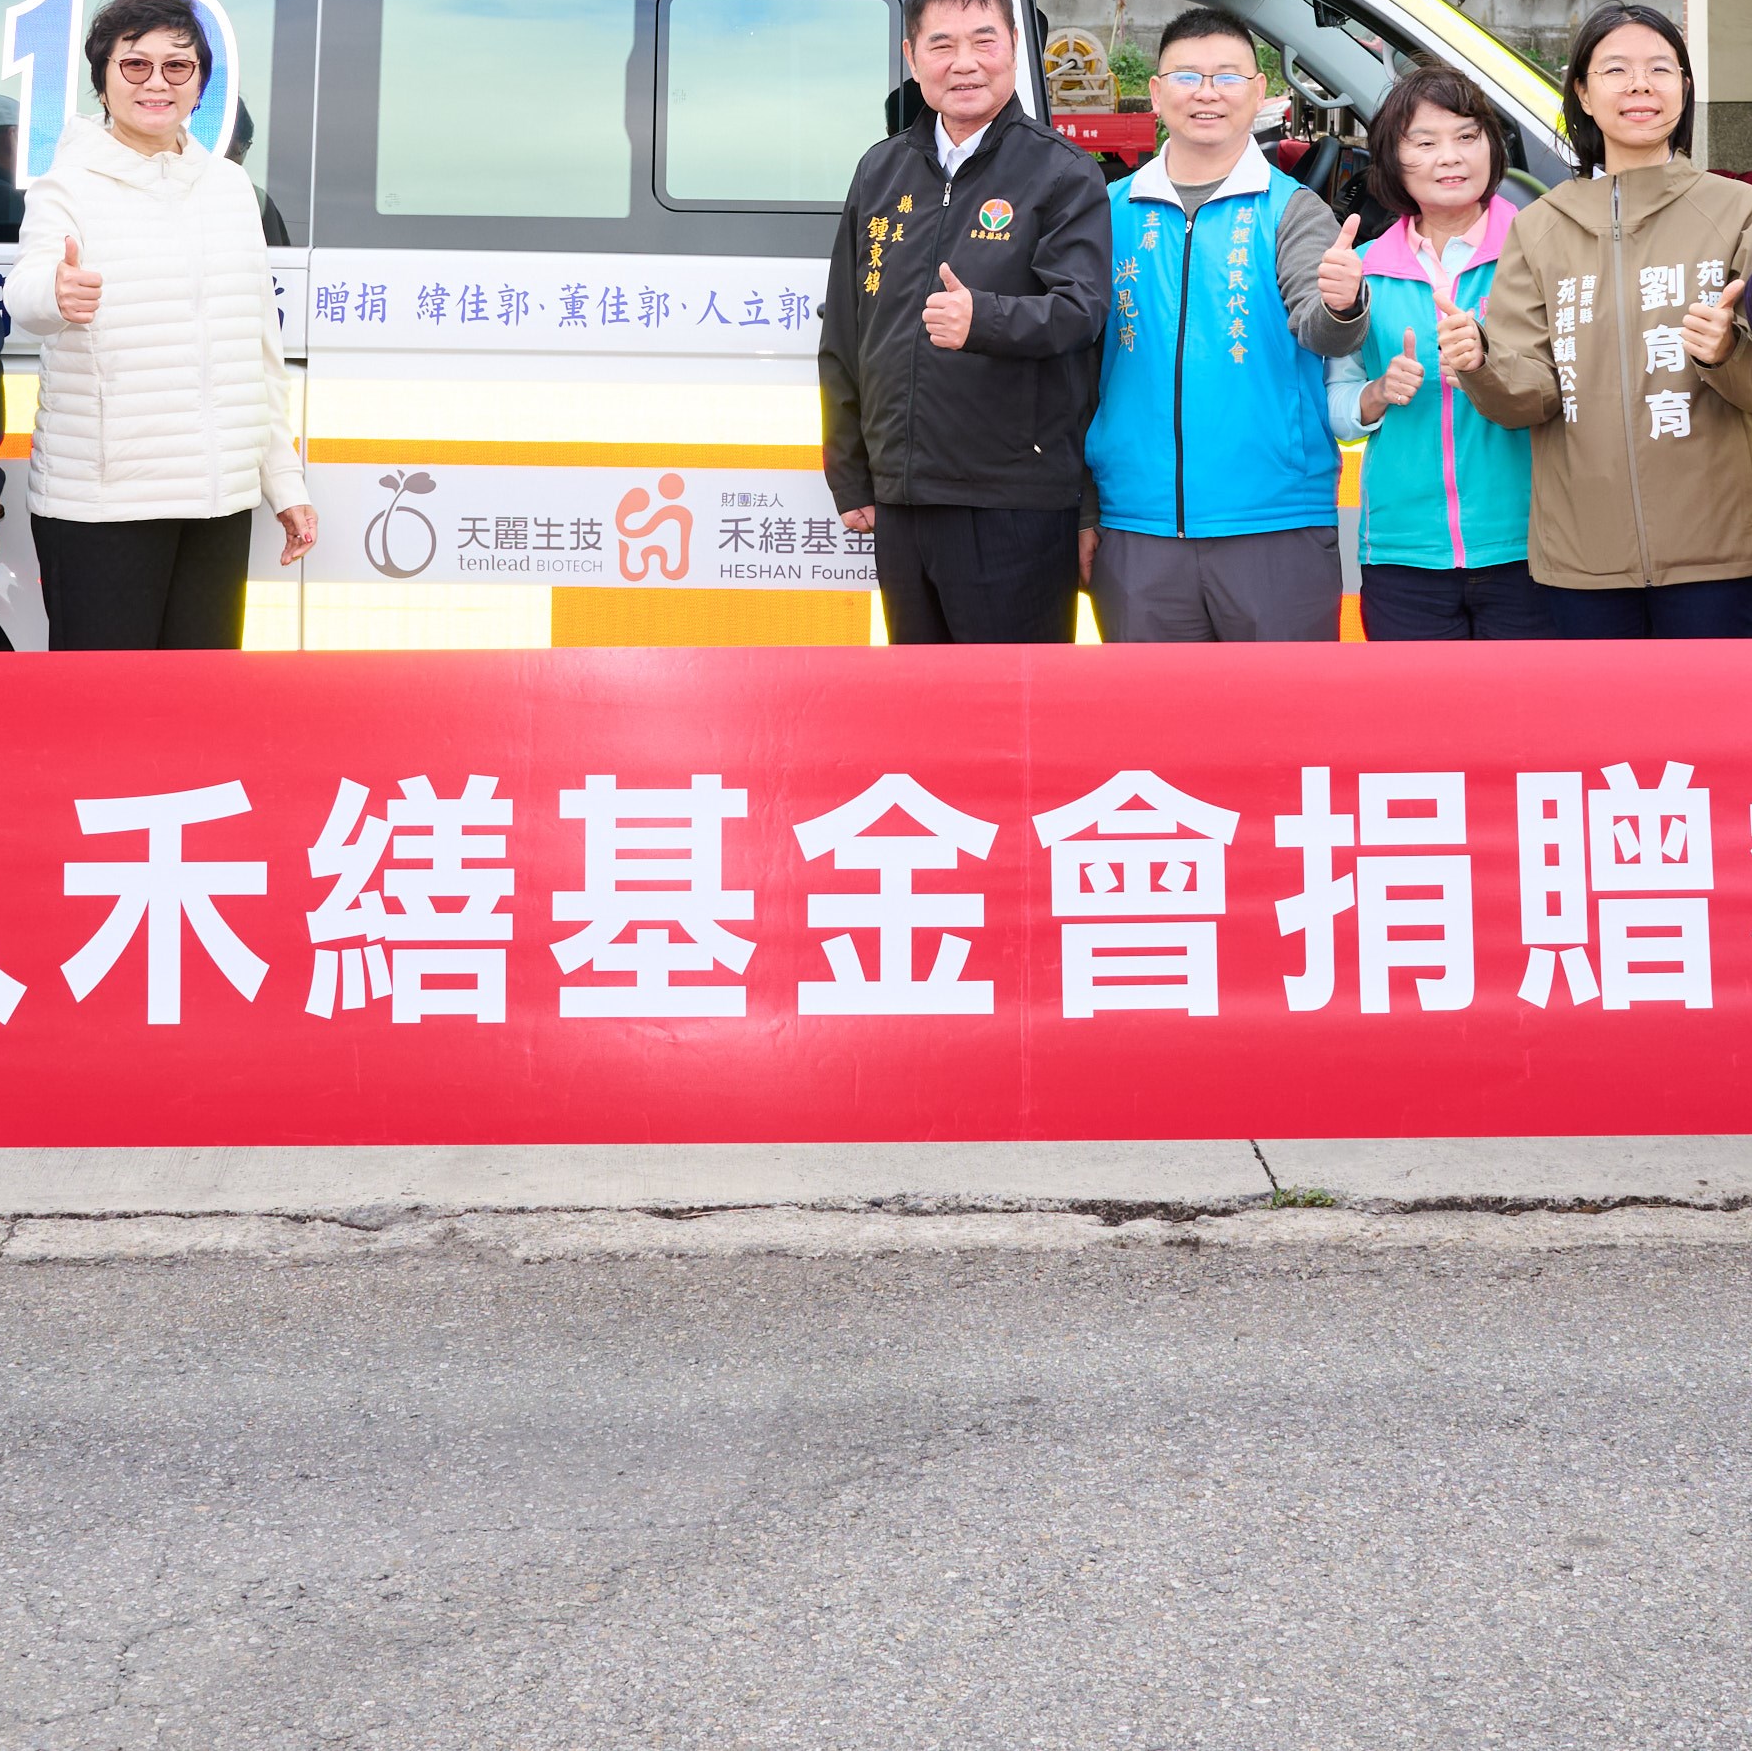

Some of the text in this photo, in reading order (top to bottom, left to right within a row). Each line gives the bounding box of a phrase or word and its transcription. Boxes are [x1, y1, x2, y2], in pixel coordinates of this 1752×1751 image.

[891, 194, 913, 243] 縣長
[1137, 210, 1161, 253] 主席
[1226, 206, 1254, 364] 苑裡鎮民代表會
[1579, 274, 1597, 324] 苗栗縣
[1639, 263, 1691, 441] 劉育育
[720, 492, 785, 508] 財團法人
[457, 516, 603, 551] 天麗生技
[718, 516, 876, 555] 禾繕基金
[457, 554, 603, 573] tenlead BIOTECH
[720, 564, 802, 579] HESHAN
